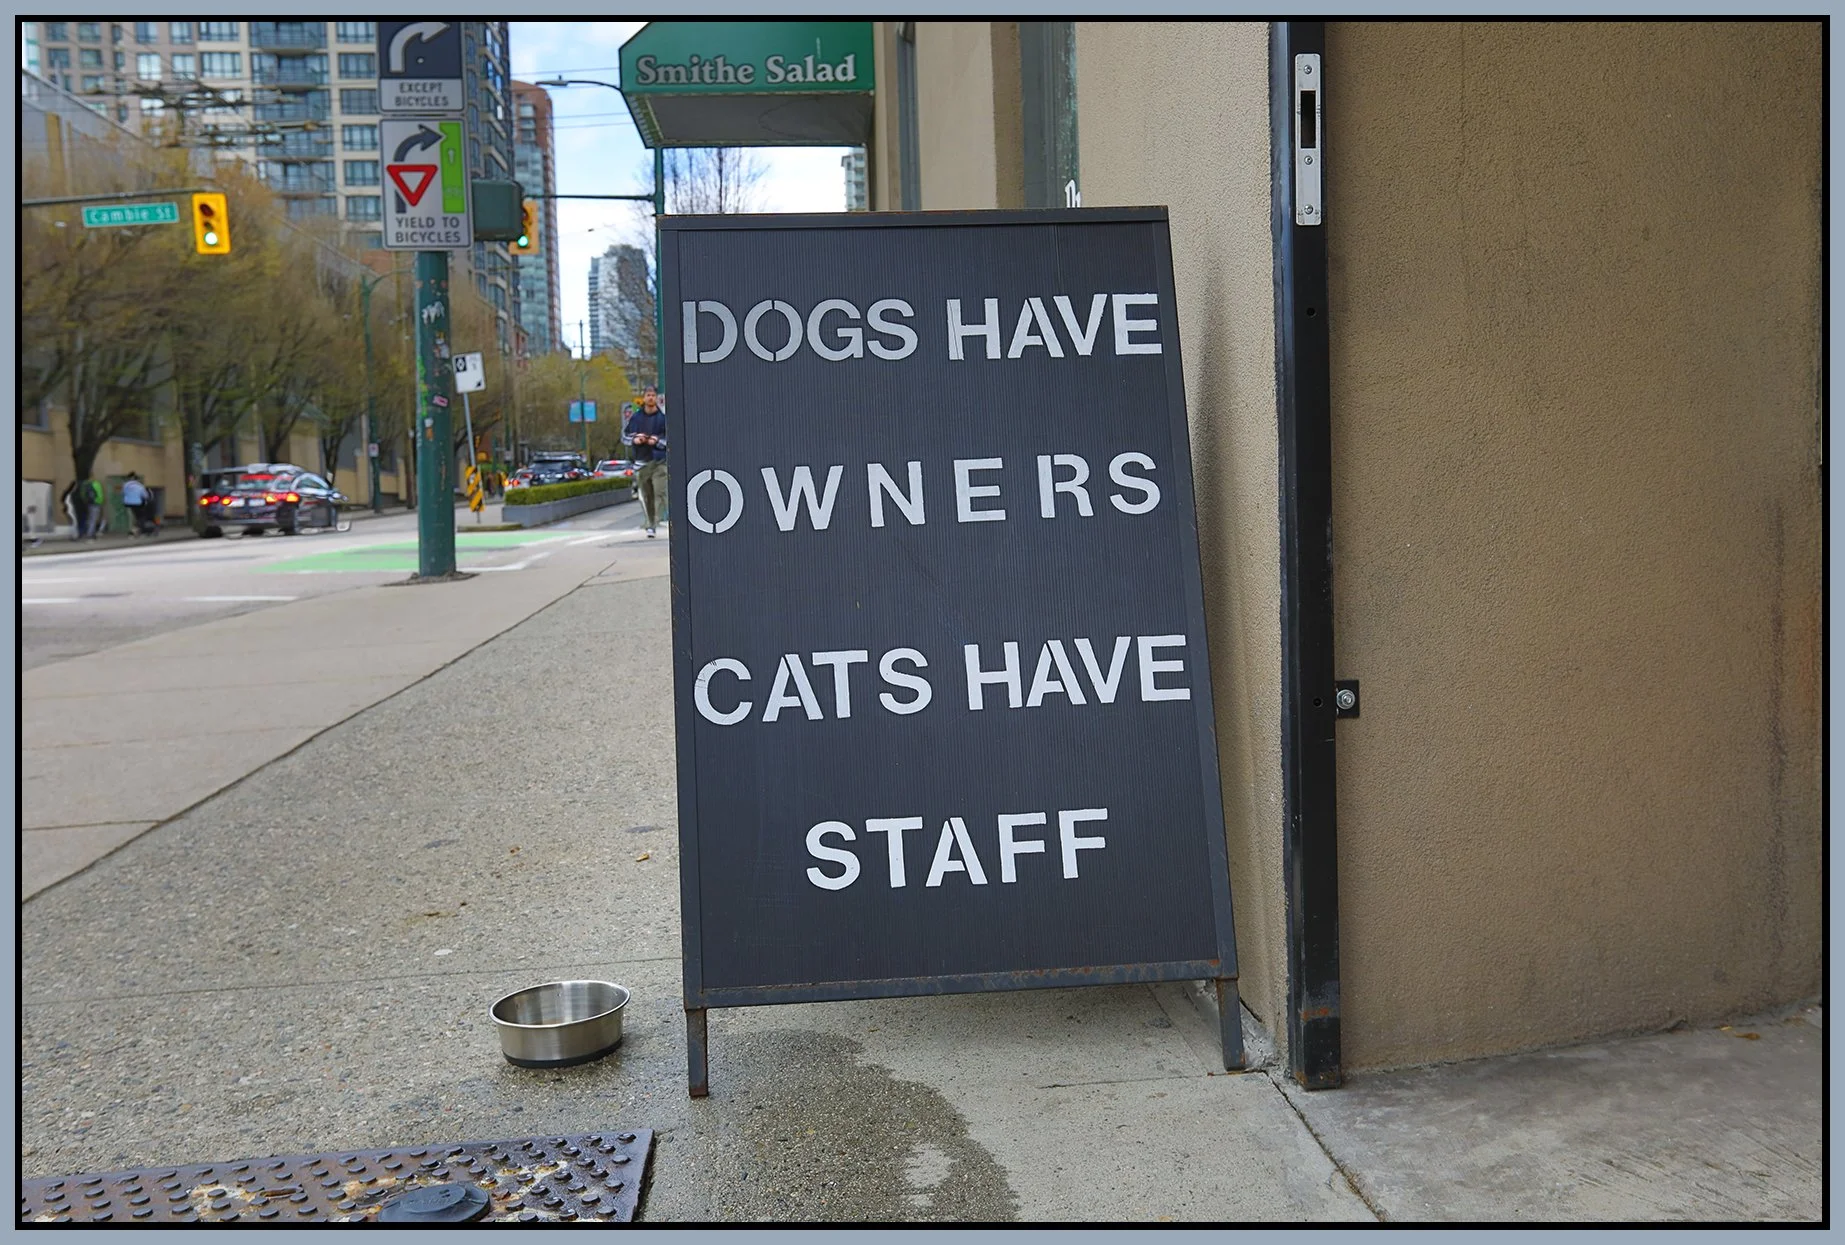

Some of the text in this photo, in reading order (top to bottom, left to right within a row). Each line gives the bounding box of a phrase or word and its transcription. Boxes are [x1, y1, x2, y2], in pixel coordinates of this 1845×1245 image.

[636, 53, 857, 85] Smithe Salad
[399, 82, 443, 93] EXCEPT
[395, 96, 449, 107] BICYCLES
[90, 206, 172, 224] Cambie St
[396, 216, 460, 229] YIELD TO
[395, 231, 461, 243] BICYCLES
[683, 293, 1164, 364] DOGS HAVE
[686, 451, 1162, 535] OWNERS
[694, 634, 1191, 726] CATS HAVE
[805, 808, 1109, 891] STAFF
